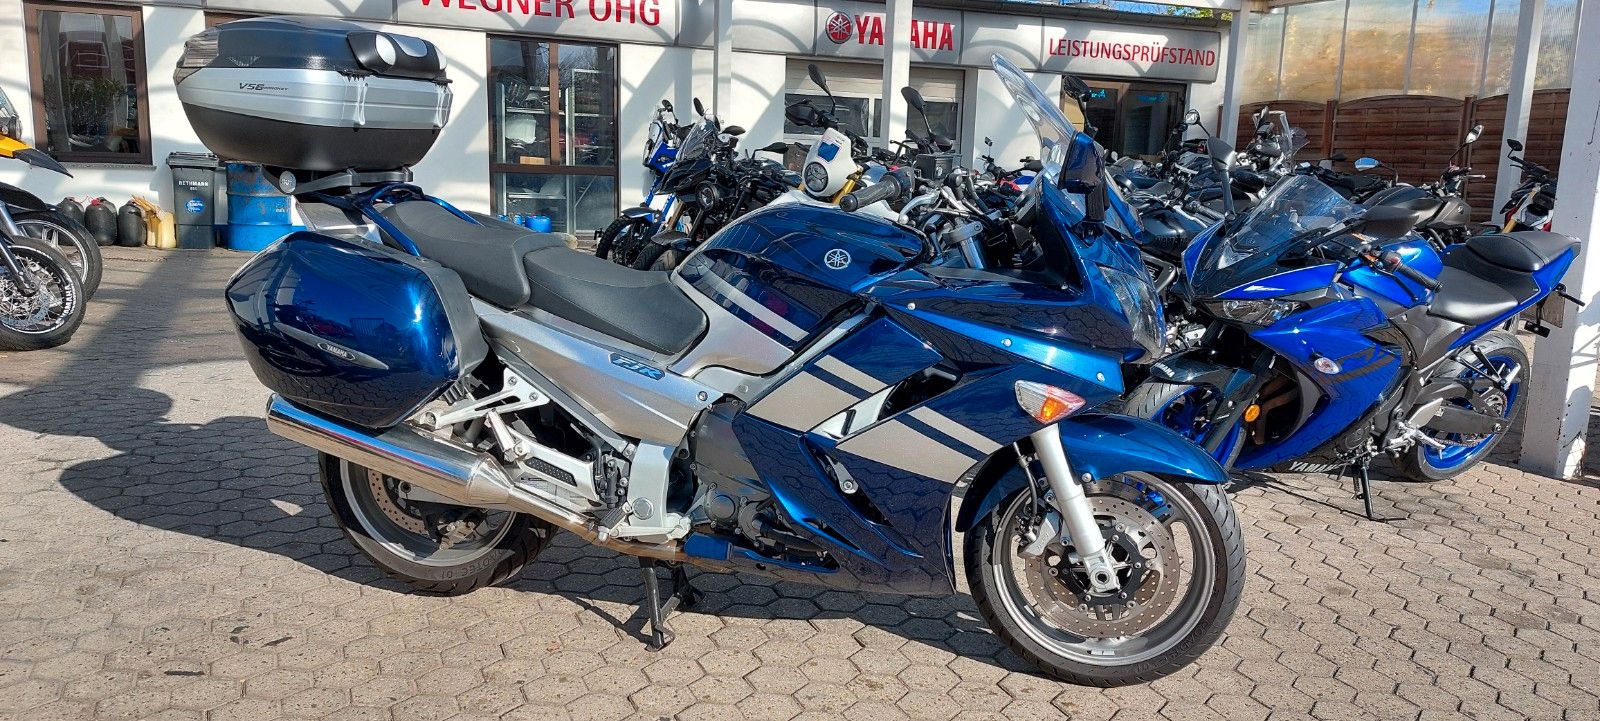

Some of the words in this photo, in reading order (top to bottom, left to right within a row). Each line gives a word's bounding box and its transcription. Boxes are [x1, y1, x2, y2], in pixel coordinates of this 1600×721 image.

[421, 0, 575, 19] GNER
[589, 0, 661, 26] OHG
[854, 14, 953, 51] YAAHA
[1049, 38, 1215, 66] LEISTUNGSPRÜFSTAND
[239, 83, 264, 91] V56
[326, 344, 347, 358] YAMAHA
[612, 355, 662, 379] FJR
